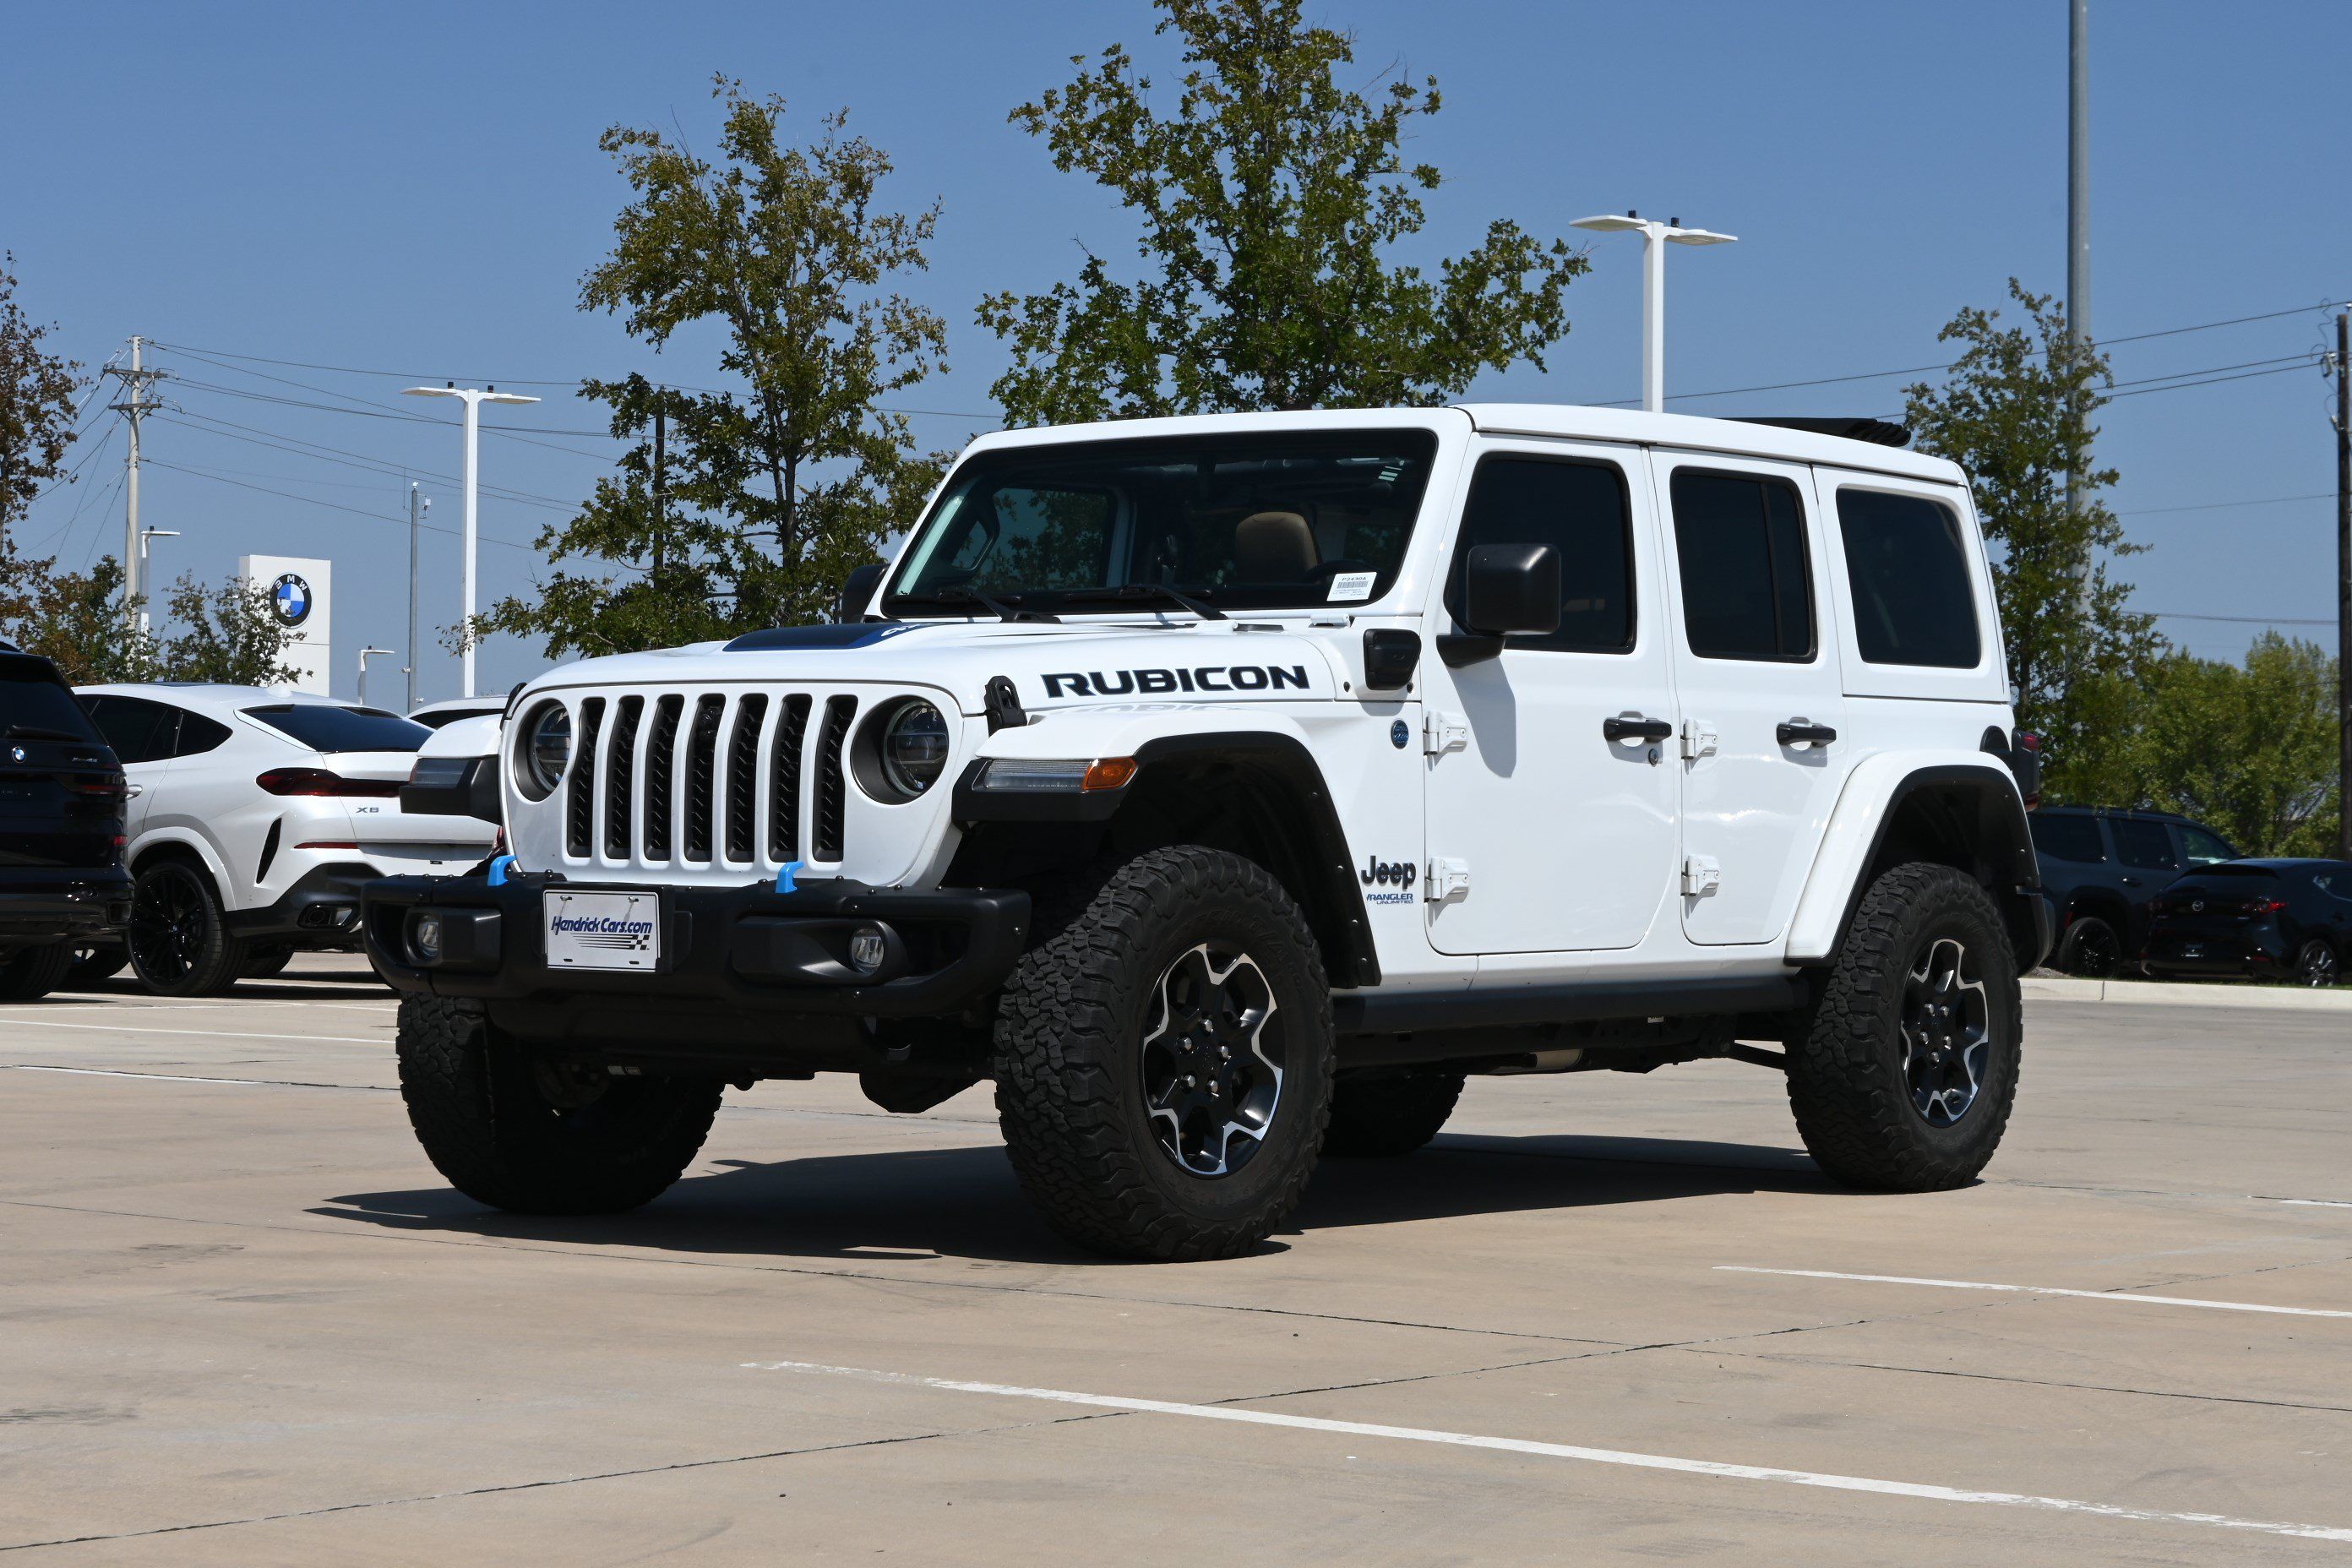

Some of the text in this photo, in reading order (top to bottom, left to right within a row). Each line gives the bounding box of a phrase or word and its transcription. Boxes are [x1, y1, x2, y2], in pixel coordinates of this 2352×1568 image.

[275, 574, 308, 591] BMW
[1040, 665, 1310, 698] RUBICON
[1361, 855, 1416, 890] Jeep
